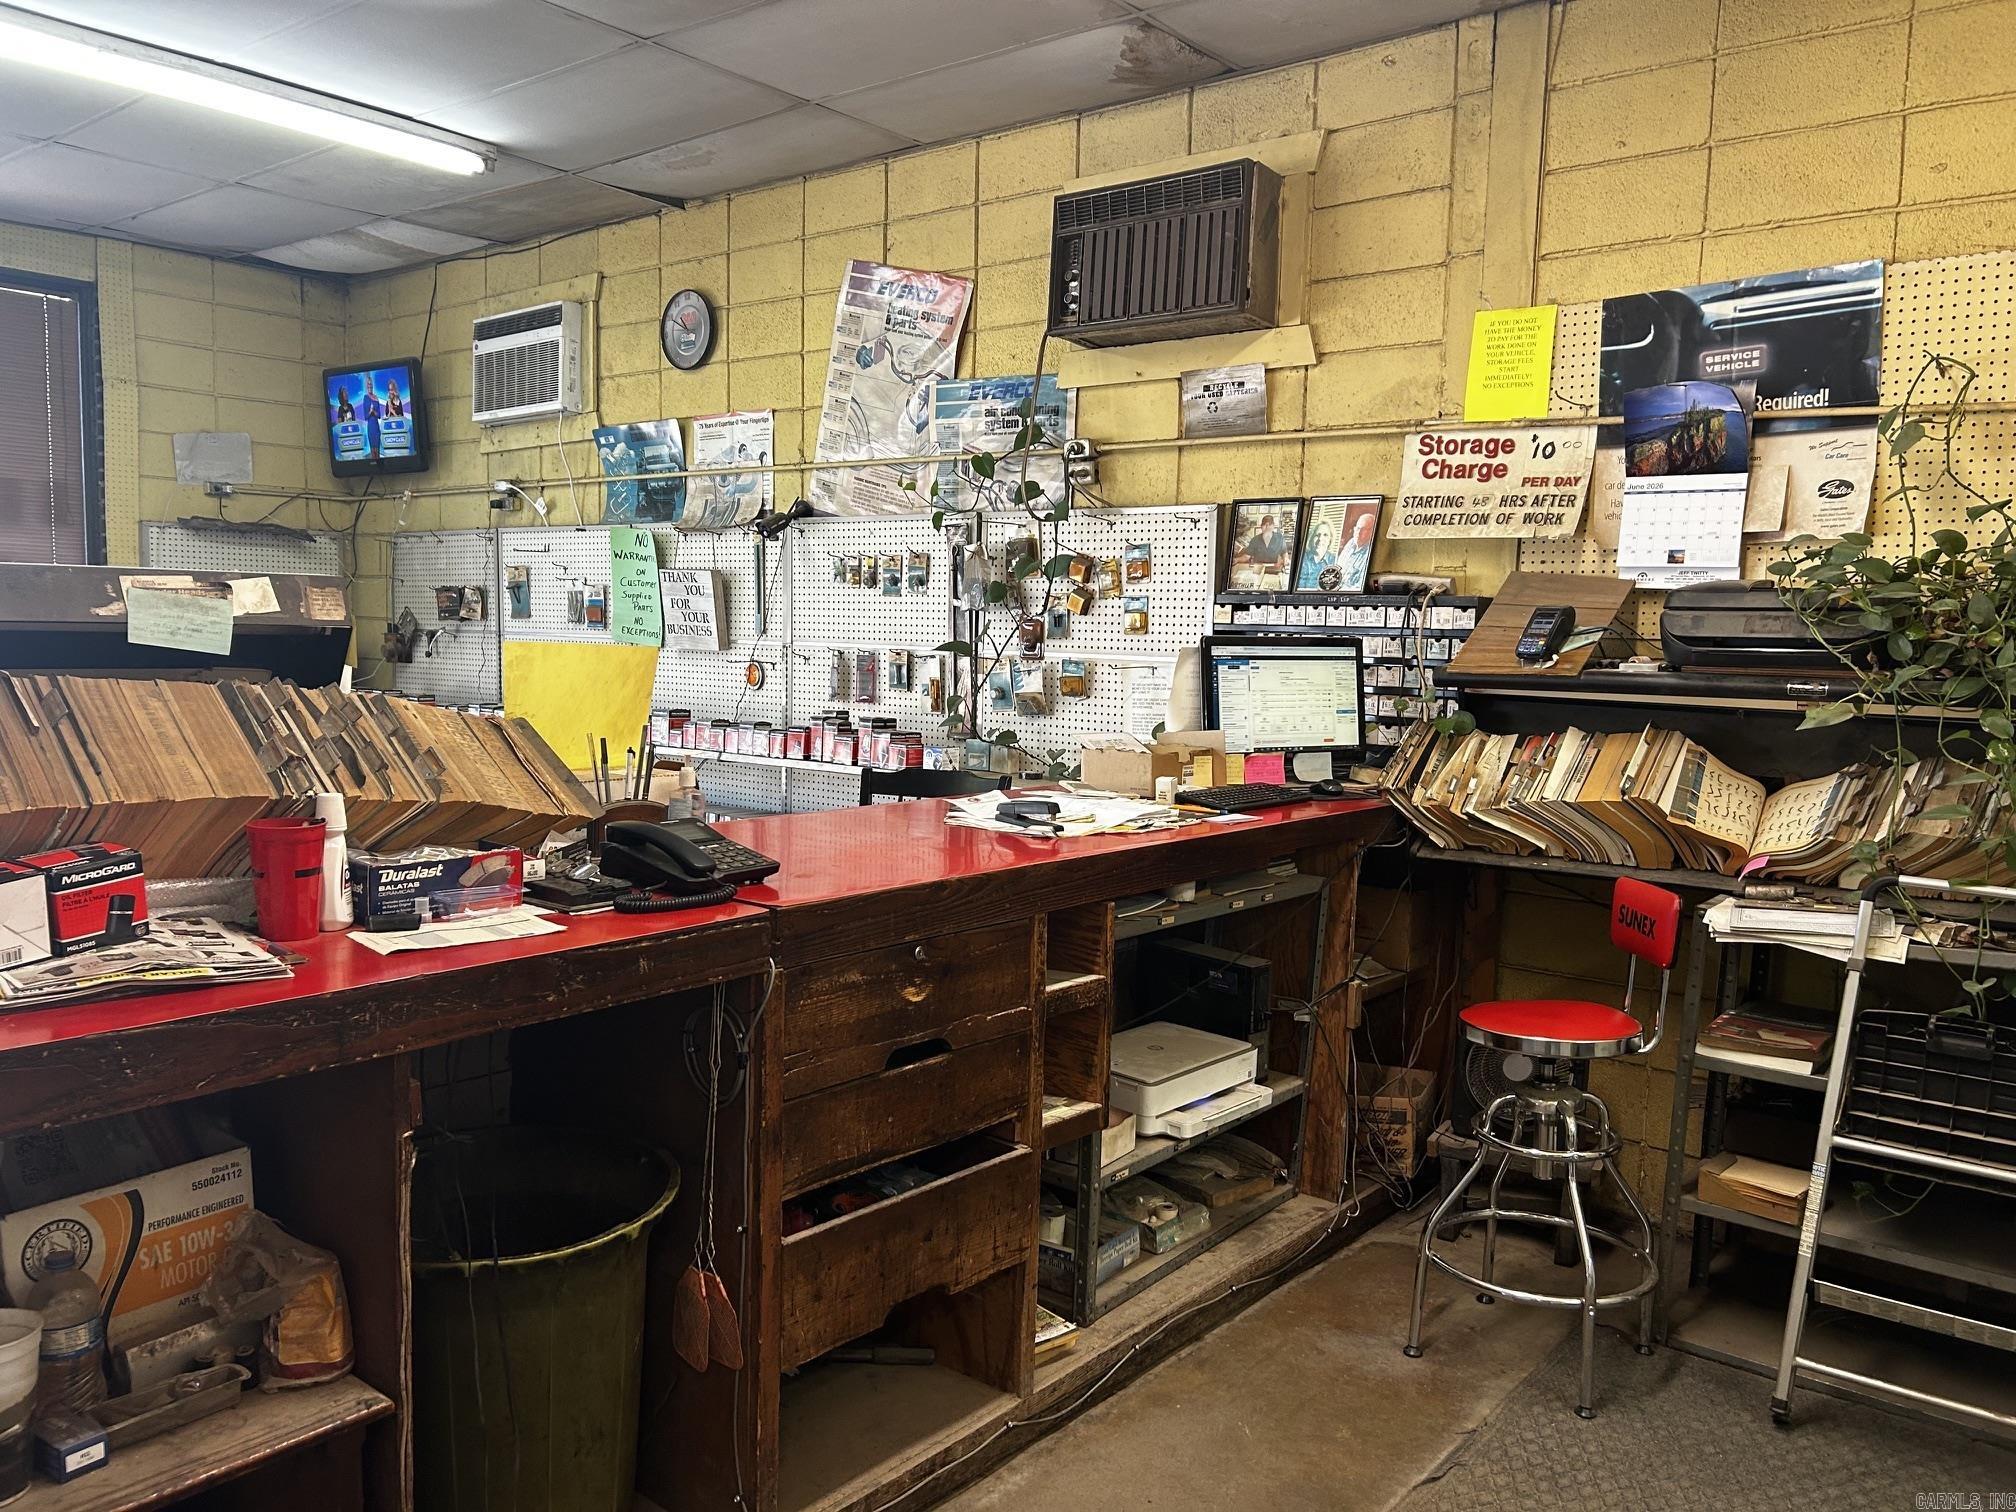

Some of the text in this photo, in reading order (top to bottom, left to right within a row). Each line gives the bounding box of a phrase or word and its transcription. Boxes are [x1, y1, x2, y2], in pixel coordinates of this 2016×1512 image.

[876, 281, 939, 304] EVERCO
[887, 302, 954, 326] heating system
[892, 317, 917, 330] parts
[1497, 319, 1512, 327] YOU
[1517, 325, 1542, 333] MONEY
[1486, 350, 1504, 358] YOUR
[1705, 350, 1761, 364] SERVICE
[1486, 358, 1516, 366] STORAGE
[1705, 359, 1760, 373] VEHICLE
[1754, 388, 1830, 412] Required!
[984, 406, 998, 418] air
[984, 418, 1020, 432] system
[1418, 434, 1516, 459] Storage
[1421, 458, 1509, 483] Charge
[1520, 476, 1582, 487] PER DAY
[1604, 481, 1615, 490] car
[1646, 482, 1664, 490] 2026
[1818, 480, 1854, 498] Gates
[1402, 495, 1465, 509] STARTING
[1499, 495, 1526, 508] HRS
[1530, 494, 1576, 508] AFTER
[1403, 512, 1565, 527] COMPLETION OF WORK
[634, 533, 649, 548] NO
[635, 568, 646, 576] ON
[662, 571, 698, 583] THANK
[683, 585, 705, 596] YOU
[670, 597, 691, 610] FOR
[633, 617, 644, 626] NO
[681, 611, 710, 624] YOUR
[667, 624, 713, 637] BUSINESS
[378, 864, 444, 883] Duralast
[378, 881, 420, 892] BALATAS
[72, 890, 93, 899] FILTER
[62, 899, 83, 908] FILTRE
[1618, 903, 1656, 941] SUNEX
[211, 1164, 229, 1174] Stock
[191, 1168, 242, 1191] 550024112
[148, 1194, 244, 1232] PERFORMANCE ENGINEERED
[24, 1221, 89, 1262] CERTIFIED
[139, 1240, 172, 1271] SAE
[161, 1252, 217, 1289] MOTOR
